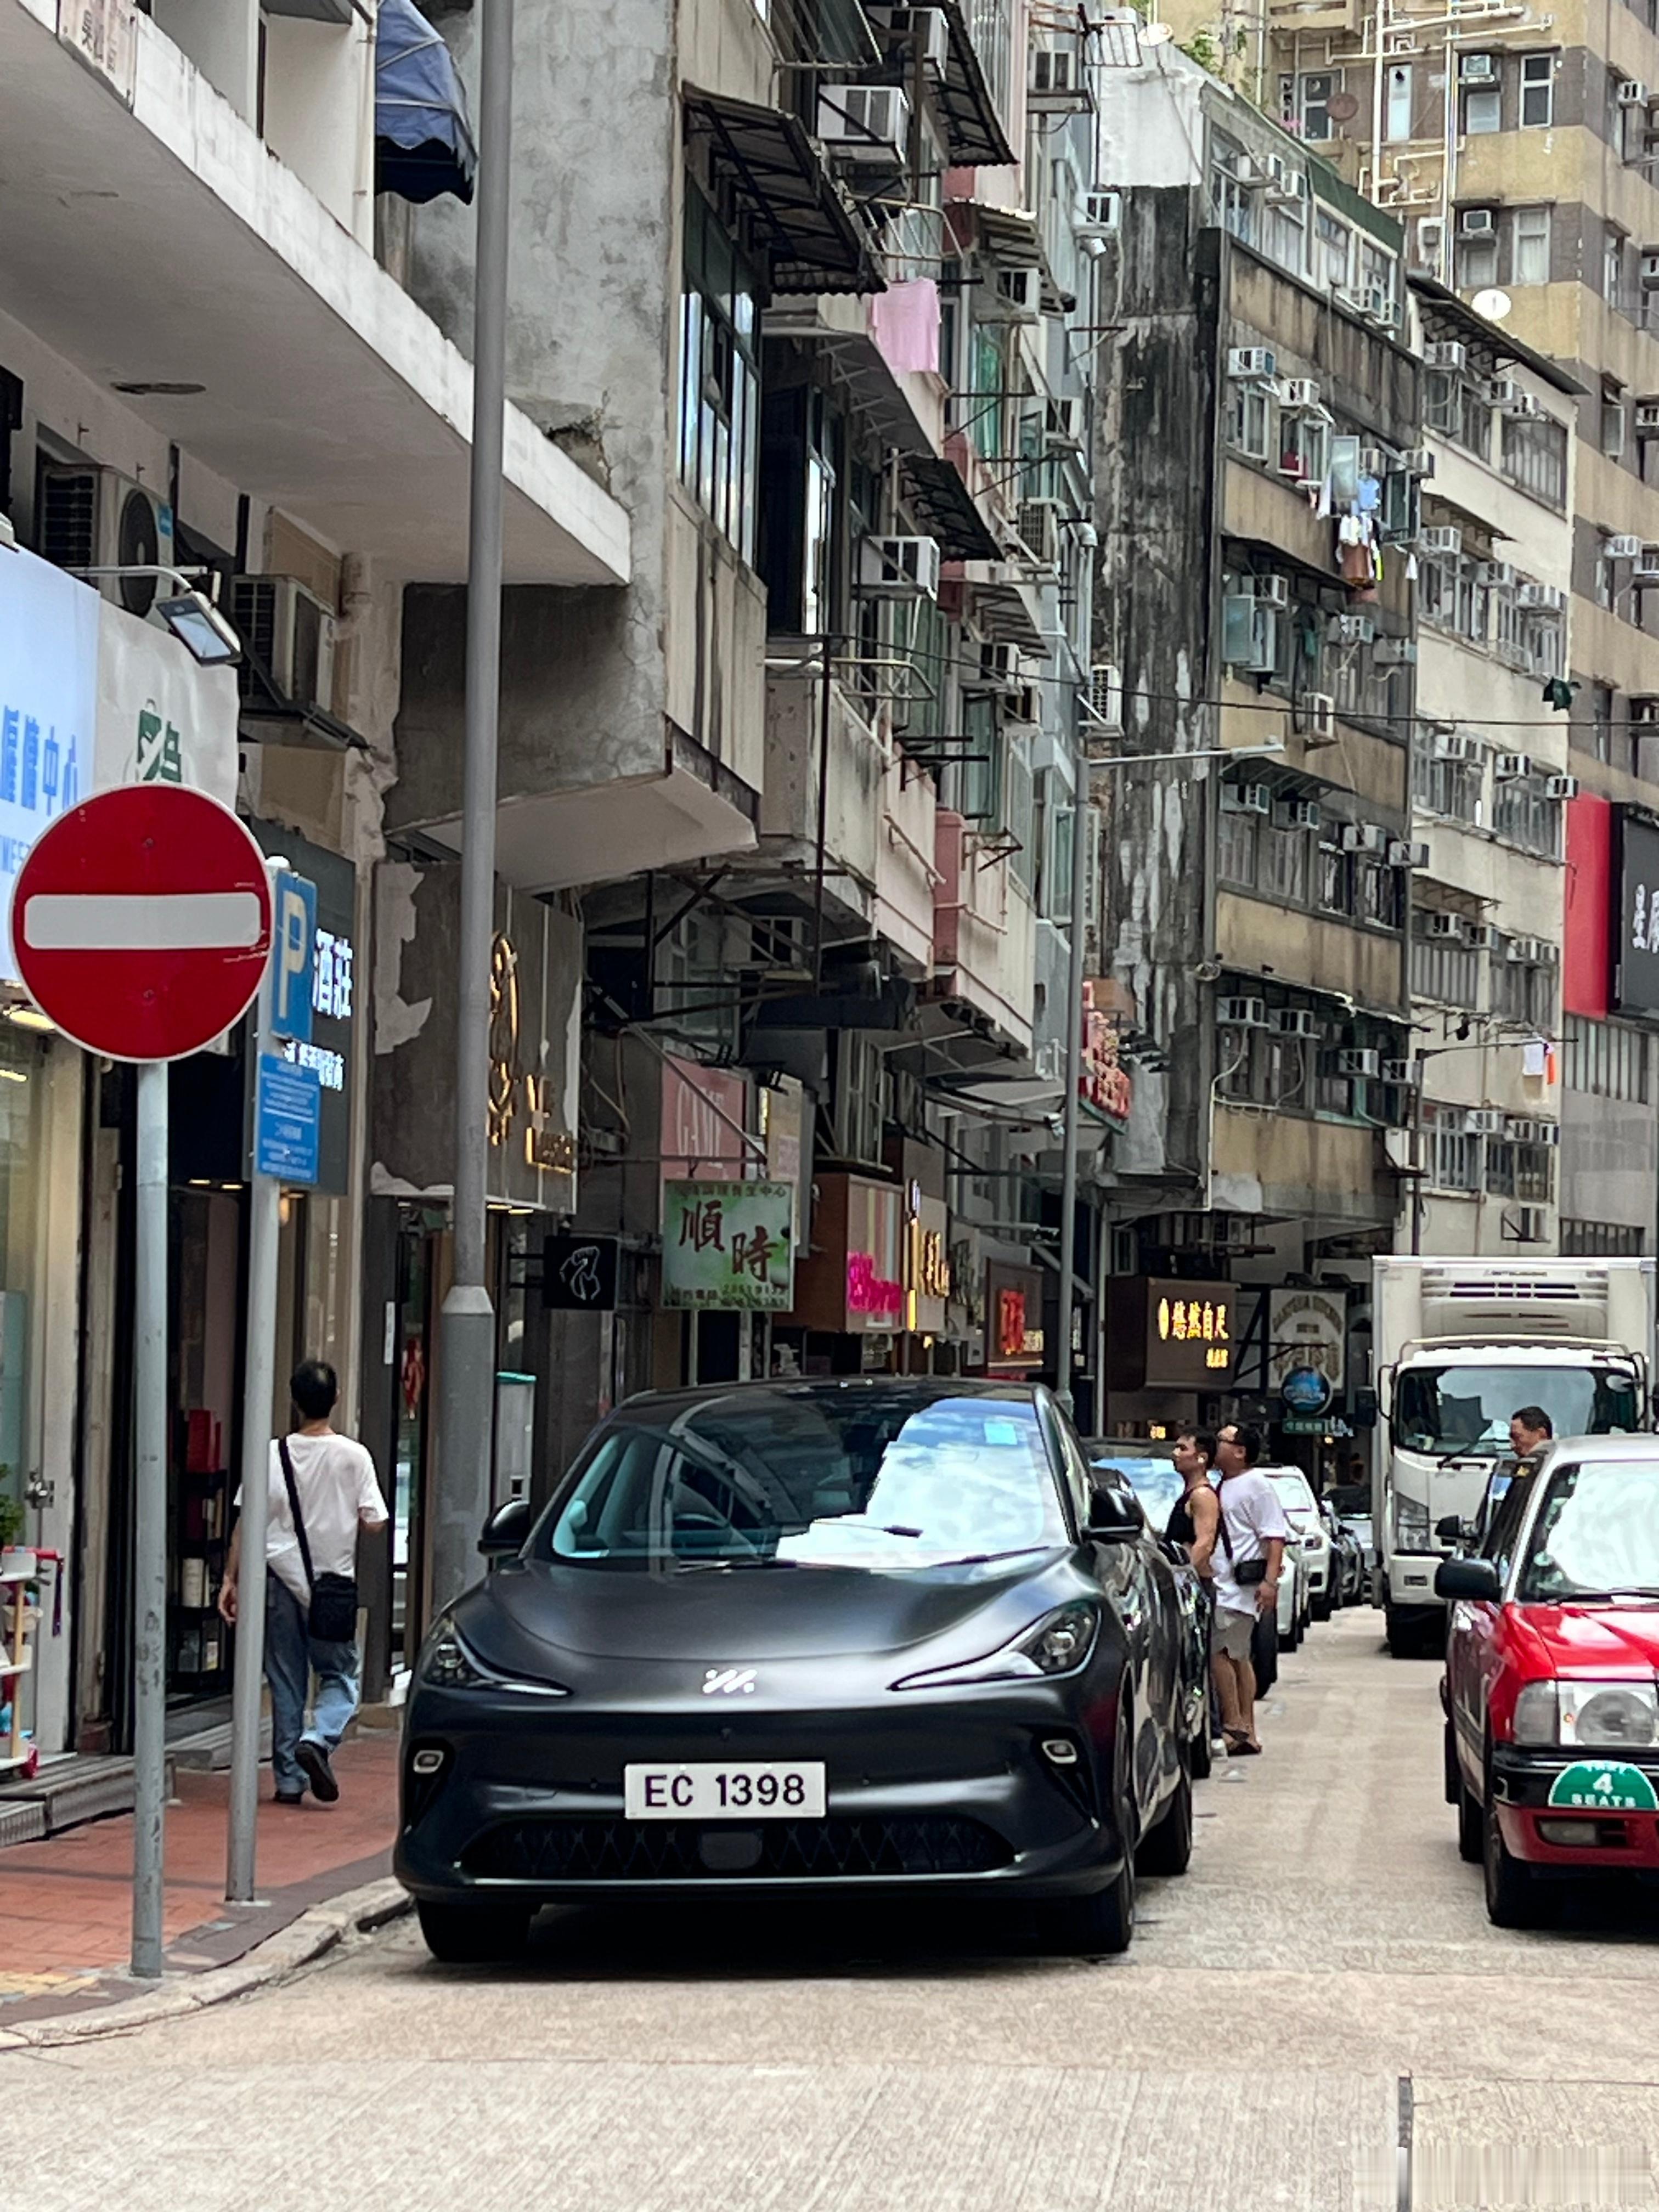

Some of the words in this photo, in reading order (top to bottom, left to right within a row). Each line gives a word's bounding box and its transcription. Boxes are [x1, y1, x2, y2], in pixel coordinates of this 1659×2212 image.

[278, 890, 307, 1019] P
[679, 1200, 780, 1283] 順時
[645, 1774, 693, 1807] EC
[715, 1774, 805, 1807] 1398
[1593, 1773, 1613, 1795] 4
